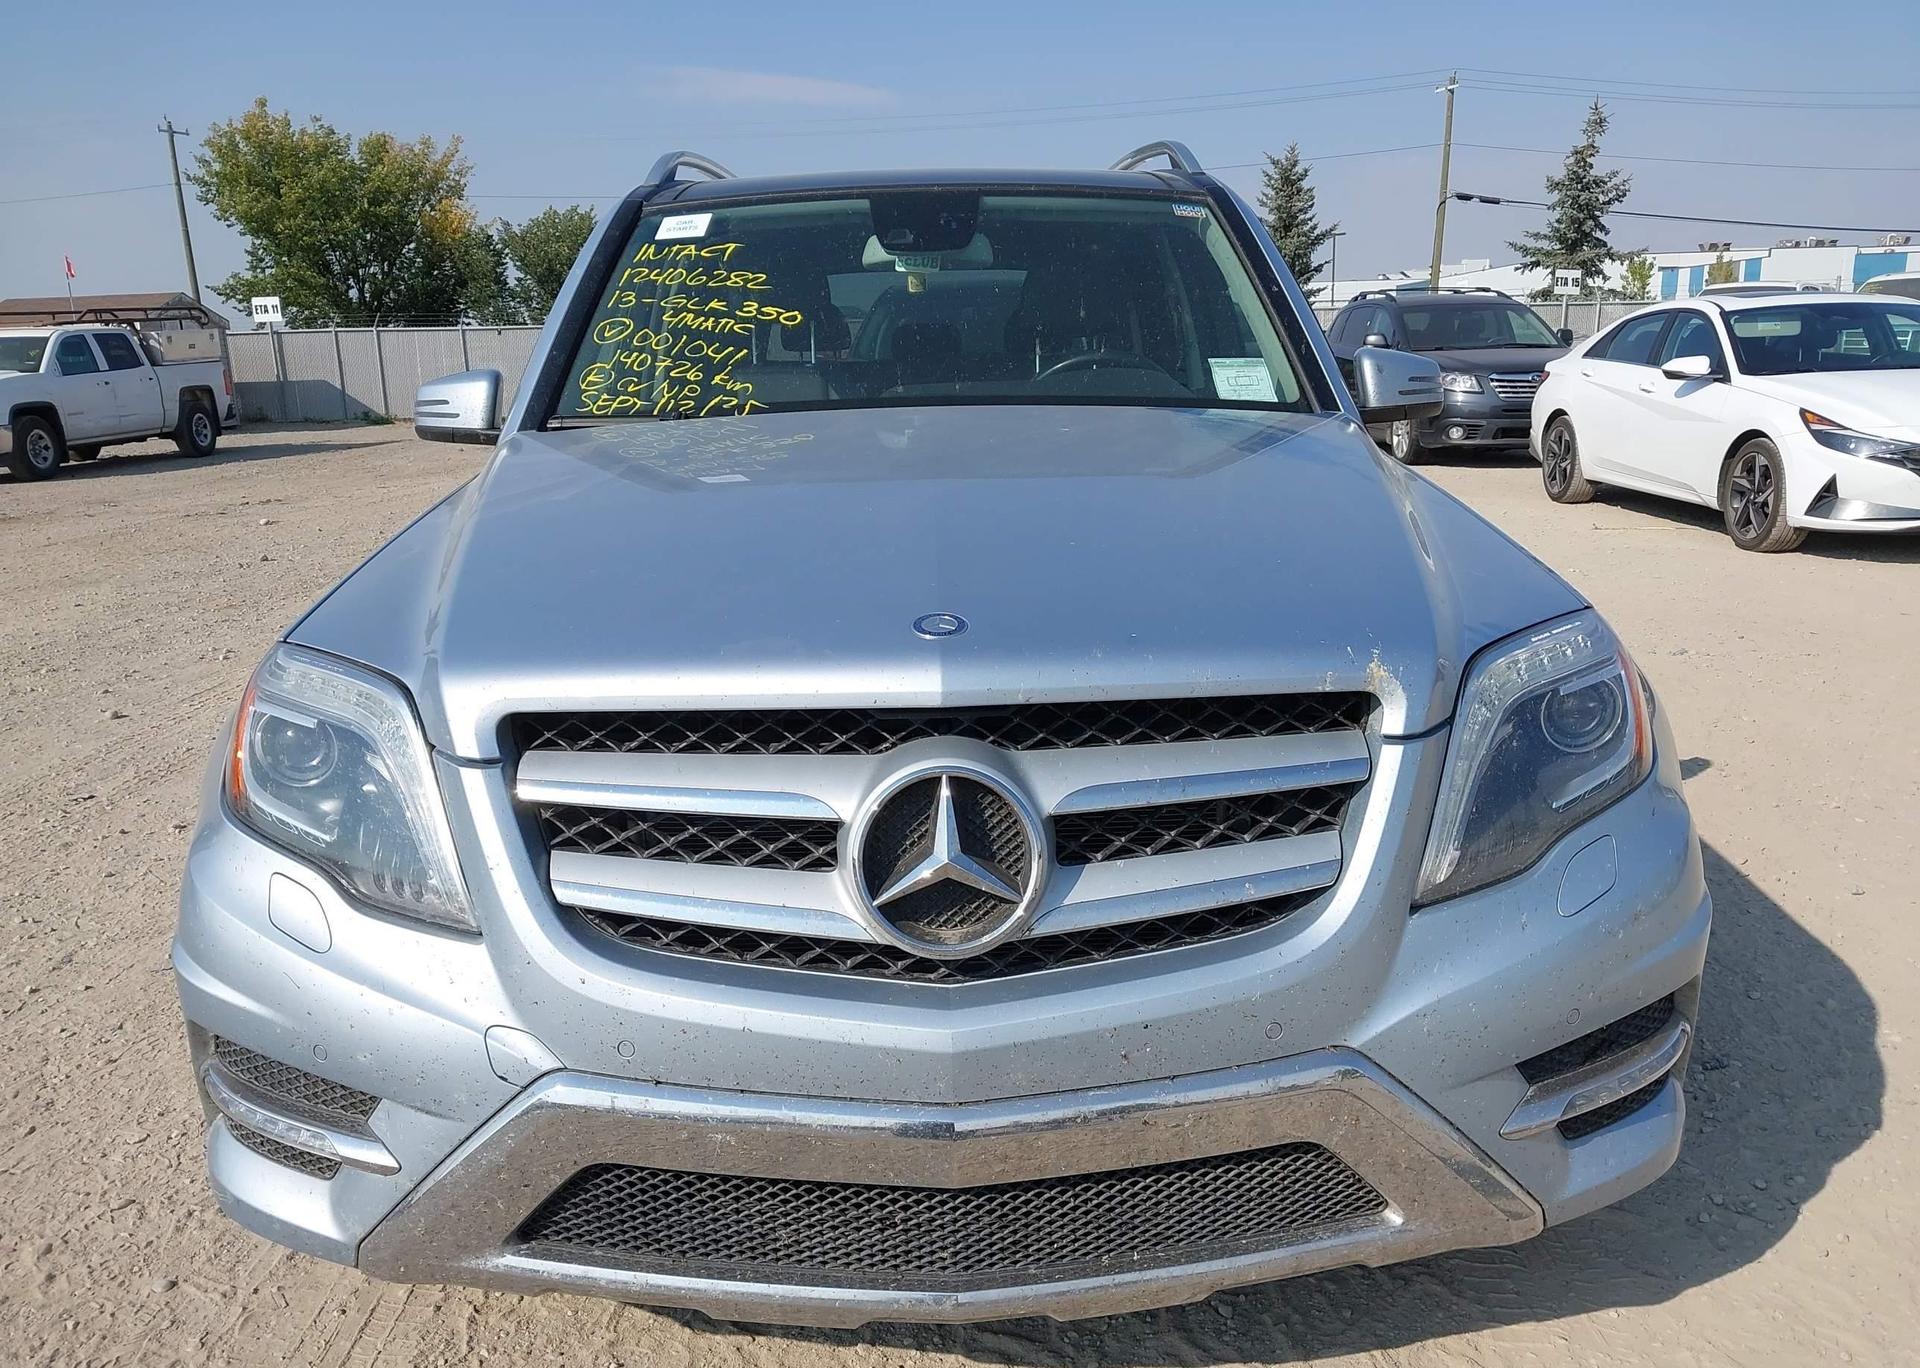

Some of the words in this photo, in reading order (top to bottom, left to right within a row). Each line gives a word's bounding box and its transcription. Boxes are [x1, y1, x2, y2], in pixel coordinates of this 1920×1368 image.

[633, 243, 745, 263] INTACT
[618, 267, 774, 290] 12406282
[1556, 276, 1569, 288] ETA
[1571, 276, 1580, 288] 15
[254, 304, 270, 315] ETA
[271, 304, 279, 314] 11
[736, 302, 804, 329] 350
[633, 328, 750, 366] 001041
[606, 349, 704, 382] 140726
